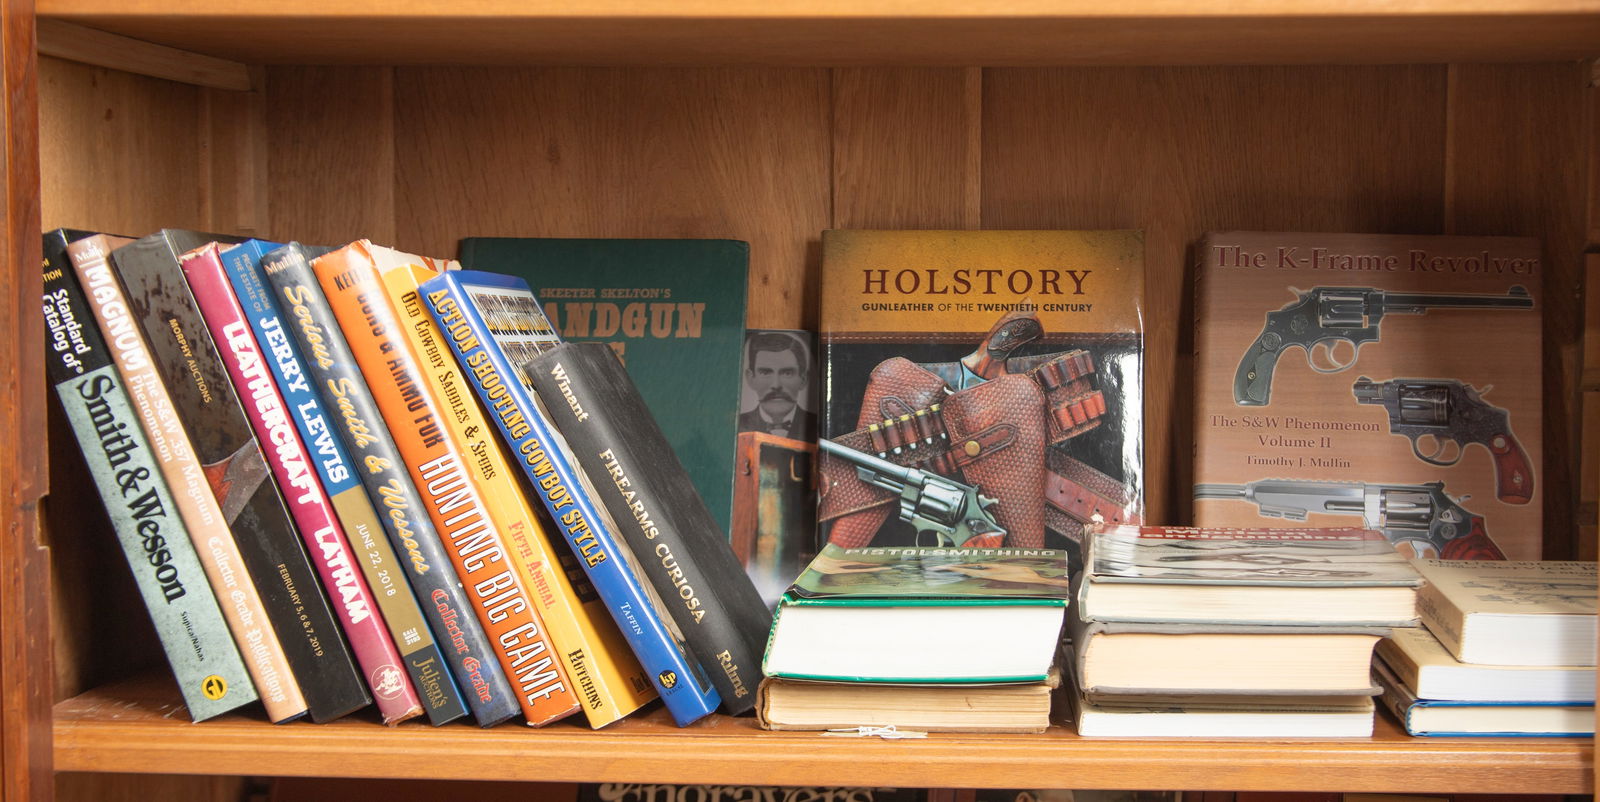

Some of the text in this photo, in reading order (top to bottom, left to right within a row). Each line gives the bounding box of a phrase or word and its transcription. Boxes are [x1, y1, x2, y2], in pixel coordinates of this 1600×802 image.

[42, 268, 63, 282] TION
[233, 257, 264, 313] THE ESTATE OF
[241, 253, 272, 310] PROPERTY FROM
[862, 269, 1092, 295] HOLSTORY
[1211, 244, 1539, 275] The K-Frame Revolver
[53, 288, 92, 354] Standard
[85, 263, 148, 371] MAGNUM
[540, 288, 671, 299] SKEETER SKELTON'S
[543, 302, 706, 339] ANDGUN
[862, 303, 1093, 312] GUNLEATHER OF THE TWENTIETH CENTURY
[168, 318, 213, 404] MORPHY AUCTIONS
[379, 341, 394, 355] &
[259, 315, 349, 484] JERRY LEWIS
[401, 291, 496, 482] OLD COWBOY SADDLES & SPURS
[127, 374, 172, 463] Phenomenon
[142, 371, 161, 398] The
[152, 398, 179, 435] S&W
[180, 464, 213, 526] Magnum
[283, 284, 430, 576] Serious Smith & Wessons
[414, 406, 449, 449] FOR
[427, 285, 608, 569] ACTION SHOOTING COWBOY STYLE
[1210, 415, 1380, 432] The S&W Phenomenon
[1258, 434, 1332, 449] Volume II
[76, 375, 187, 605] Smith & Wesson
[223, 319, 370, 624] LEATHERCRAFT LATHAM
[1247, 455, 1351, 469] Timothy J. Mullin
[418, 456, 502, 574] HUNTING
[549, 362, 746, 699] Winant FIREARMS CURIOSA Riling
[208, 536, 238, 591] Collector
[356, 523, 396, 597] JUNE 22, 2018
[507, 520, 555, 610] FIFTH ANNUAL
[845, 548, 1057, 556] PISTOLSMITHING
[278, 564, 301, 605] FEBRUARY
[310, 637, 324, 657] 2019
[474, 570, 527, 625] BIG
[620, 601, 644, 636] TAFFIN
[180, 610, 205, 662] Supica/Nahas
[430, 588, 492, 704] Collector Grade
[498, 622, 567, 707] GAME
[412, 656, 448, 707] Julien's
[567, 648, 604, 711] HUTCHINS
